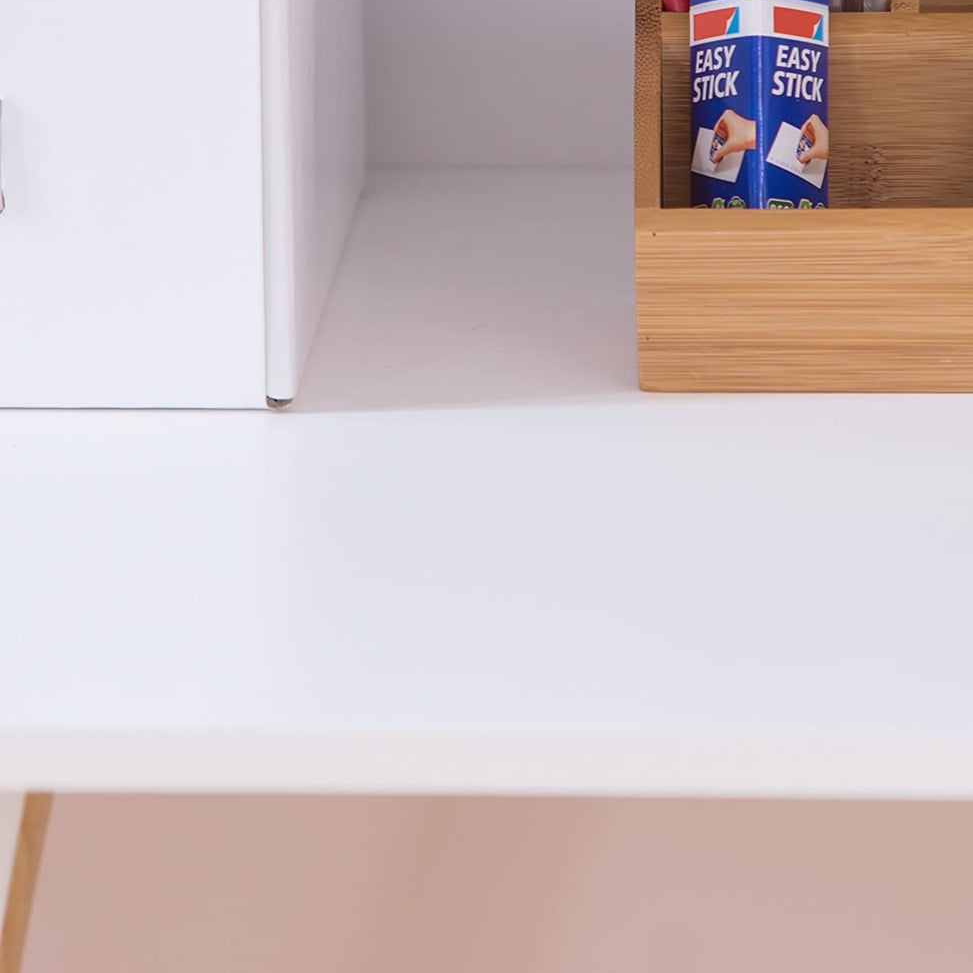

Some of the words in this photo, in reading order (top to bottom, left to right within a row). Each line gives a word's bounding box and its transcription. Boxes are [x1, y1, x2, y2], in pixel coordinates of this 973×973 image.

[695, 44, 737, 74] EASY
[775, 44, 821, 73] EASY
[692, 70, 740, 103] STICK
[771, 70, 824, 102] STICK
